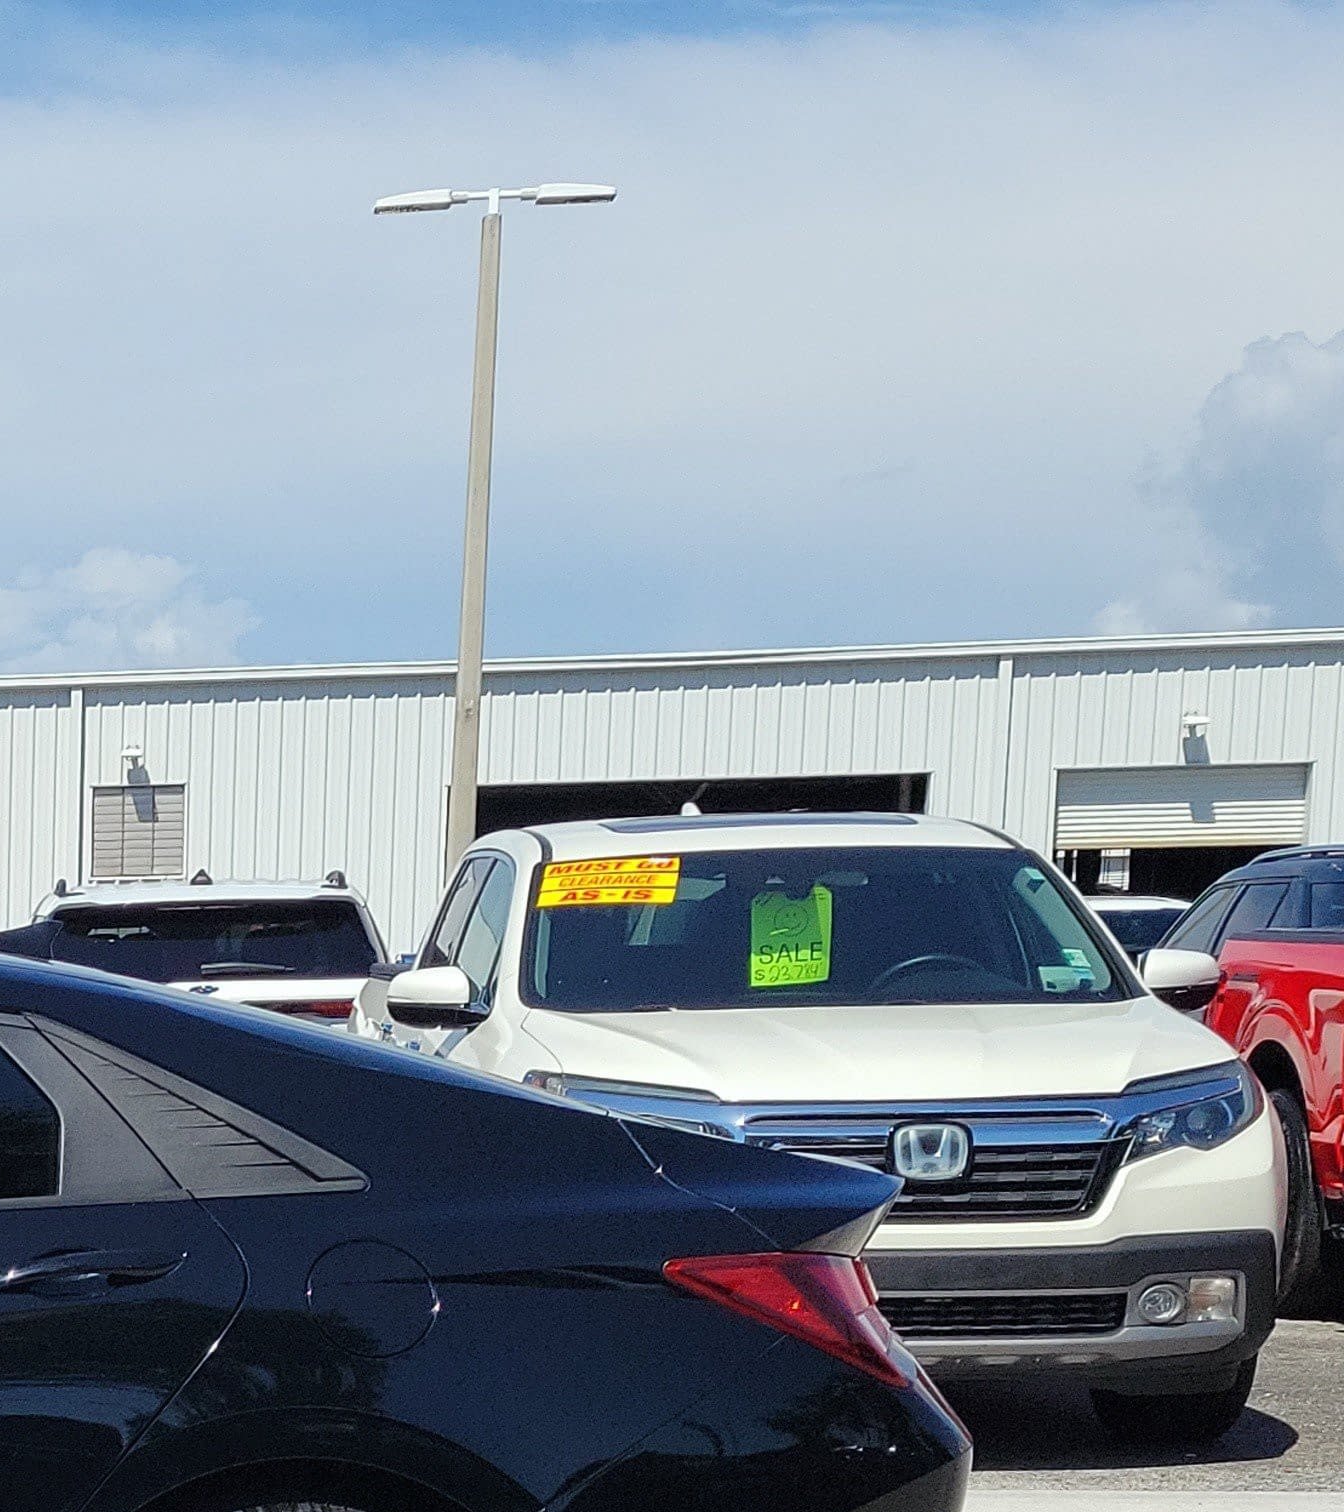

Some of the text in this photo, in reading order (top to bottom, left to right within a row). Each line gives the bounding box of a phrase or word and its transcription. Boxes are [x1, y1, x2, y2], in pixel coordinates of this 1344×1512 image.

[549, 861, 625, 876] MUST
[559, 874, 657, 888] CLEARANCE
[759, 941, 823, 965] SALE
